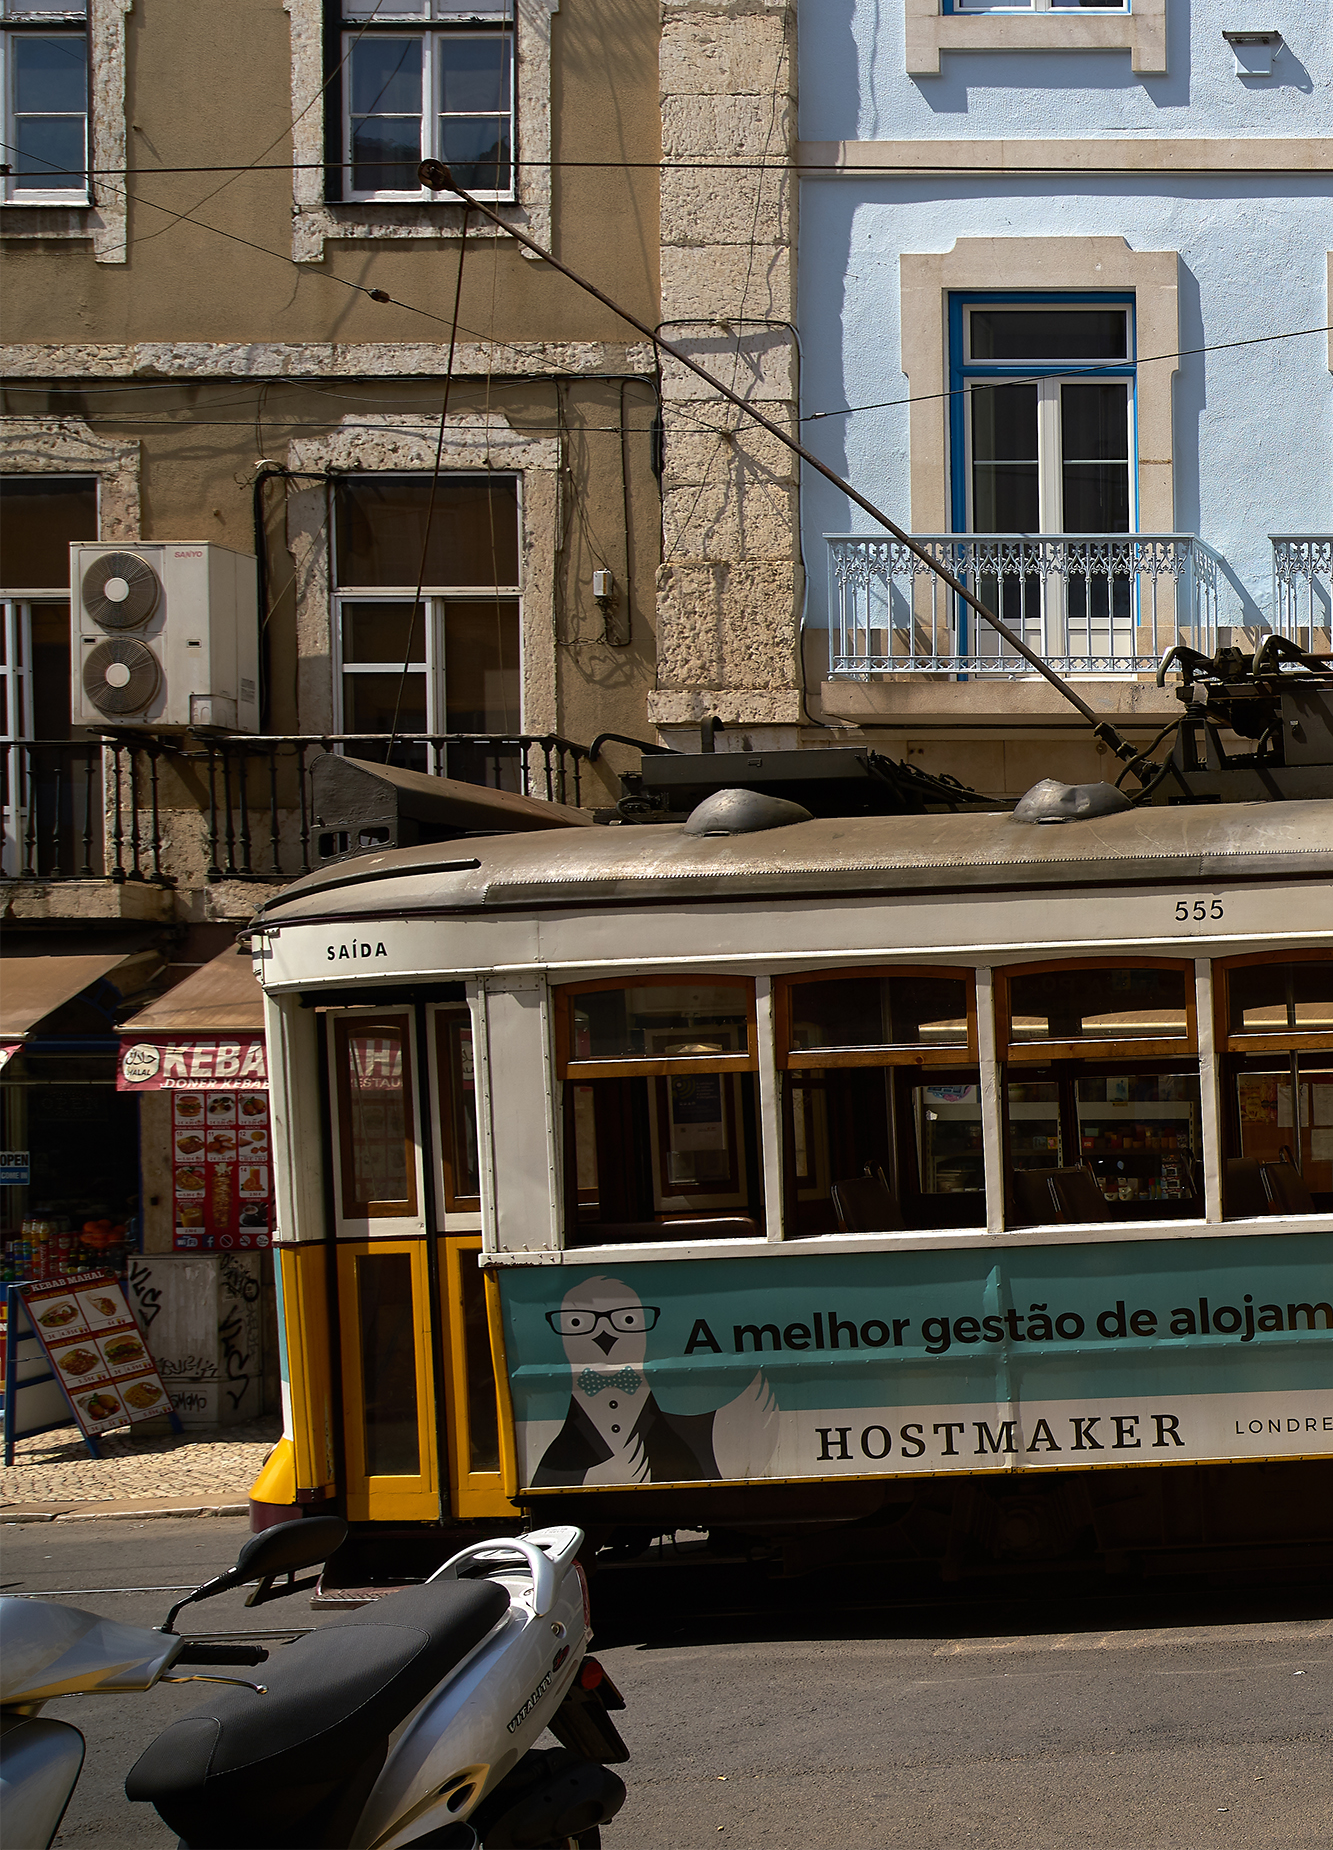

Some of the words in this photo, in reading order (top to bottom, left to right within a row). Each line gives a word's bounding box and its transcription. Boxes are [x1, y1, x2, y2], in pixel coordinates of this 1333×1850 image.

[174, 550, 203, 558] SANYO
[1174, 899, 1224, 921] 555
[327, 938, 388, 961] SAÍDA
[163, 1040, 266, 1077] KEBA
[127, 1068, 151, 1076] HALAL
[351, 1077, 402, 1088] ESTAU
[165, 1078, 218, 1089] DONER
[0, 1154, 29, 1166] OPEN
[30, 1278, 67, 1292] KEBAB
[66, 1271, 105, 1285] MAHAL
[684, 1319, 723, 1354] A
[733, 1311, 911, 1351] melhor
[921, 1303, 1086, 1354] gestão
[1096, 1300, 1159, 1338] de
[815, 1414, 1186, 1461] HOSTMAKER
[507, 1670, 552, 1733] VITALITY
